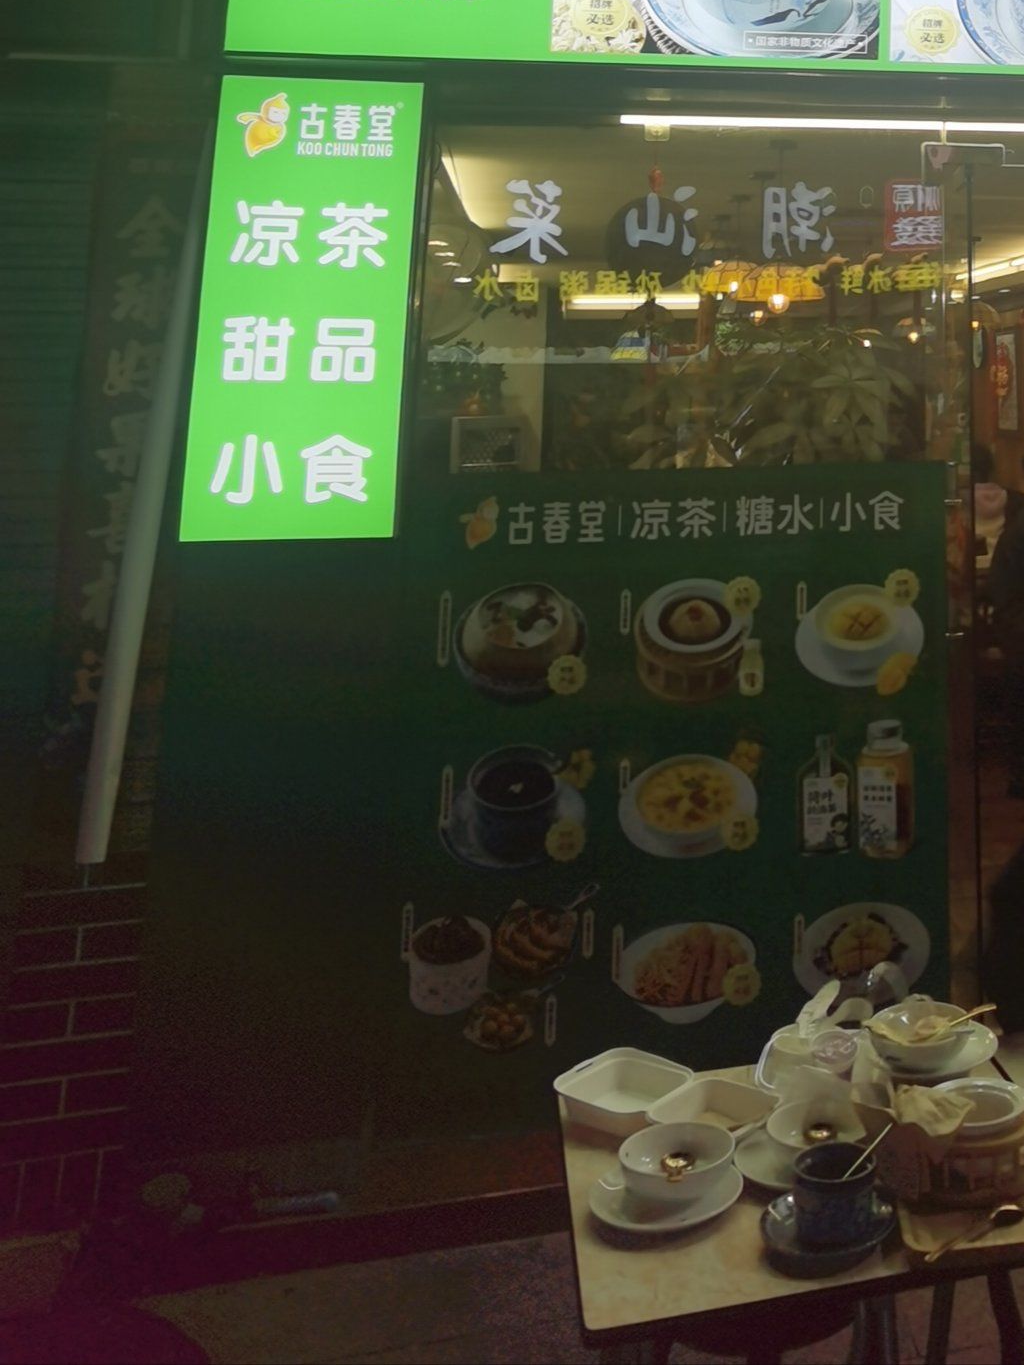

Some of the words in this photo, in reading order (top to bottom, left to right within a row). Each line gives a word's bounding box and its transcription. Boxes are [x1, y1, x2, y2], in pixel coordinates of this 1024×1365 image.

[591, 0, 612, 10] 招牌
[587, 13, 614, 25] 必选
[756, 36, 856, 50] 国家非物质文化遗产
[921, 32, 944, 44] 必选
[301, 103, 395, 140] 古春堂
[297, 141, 322, 156] KOO
[325, 142, 358, 157] CHUN
[361, 142, 393, 157] TONG
[230, 200, 389, 268] 凉茶
[223, 316, 375, 382] 甜品
[211, 434, 372, 504] 小食
[508, 501, 606, 545] 古春堂
[630, 498, 716, 540] 凉茶
[736, 495, 813, 536] 糖水
[831, 491, 905, 532] 小食
